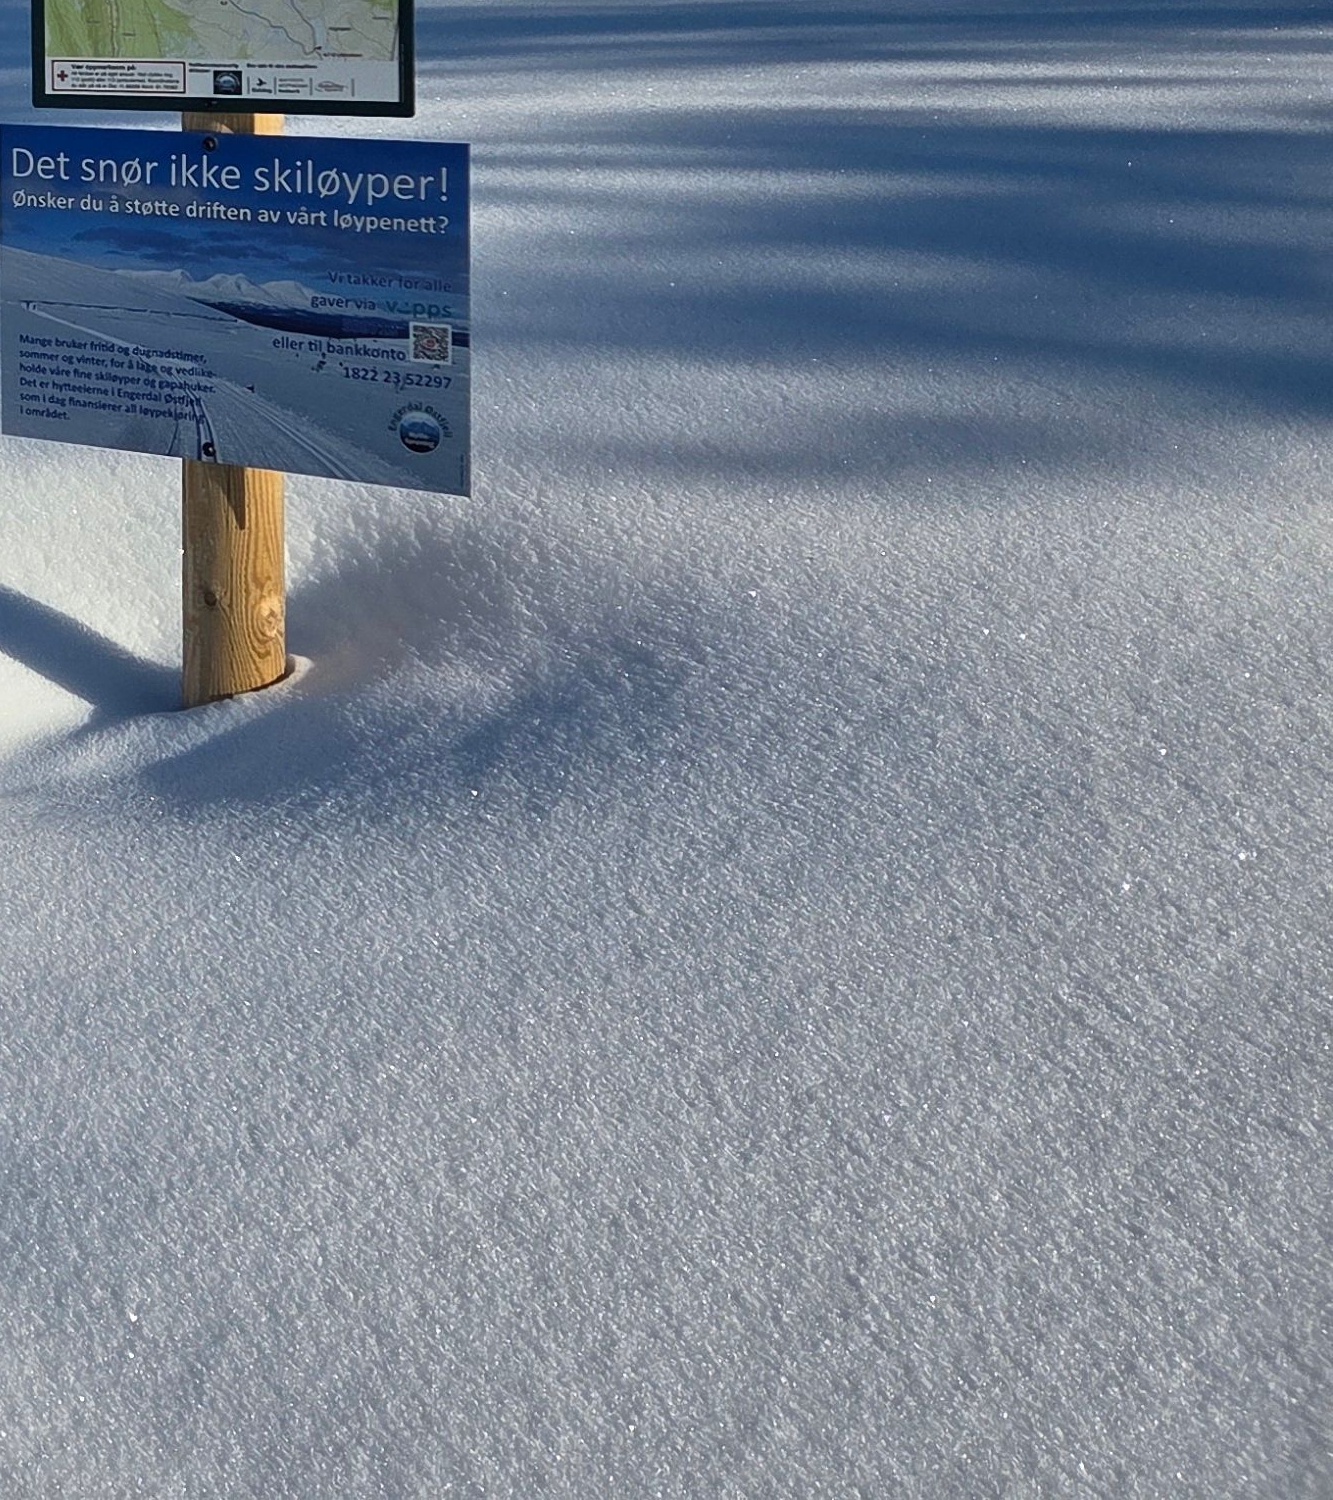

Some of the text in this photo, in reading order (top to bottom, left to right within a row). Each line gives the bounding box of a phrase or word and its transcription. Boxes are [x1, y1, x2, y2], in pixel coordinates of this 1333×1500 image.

[12, 148, 448, 206] Det snør ikke skiløyper!
[12, 189, 449, 234] Ønsker du å støtte driften av vårt løypenett?
[327, 271, 452, 293] Vi takker for alle
[310, 296, 351, 309] gaver
[354, 299, 376, 311] via
[19, 334, 207, 364] Mange bruker fritid og dugnadstimer,
[272, 337, 407, 361] eller til bankkonto
[19, 351, 59, 361] sommer
[62, 354, 74, 365] og
[76, 354, 108, 368] vinter,
[110, 358, 125, 368] for
[127, 358, 133, 370] å
[136, 359, 158, 374] lage
[160, 365, 173, 376] og
[19, 363, 216, 394] holde våre fine skiløyper og gapahuker.
[19, 377, 37, 387] Det
[39, 380, 50, 389] er
[52, 379, 109, 397] hytteeierne
[117, 388, 162, 402] Engerdal
[344, 366, 452, 389] 1822 23 52297
[20, 393, 41, 403] som
[48, 395, 67, 407] dag
[68, 396, 122, 413] finansierer
[124, 402, 137, 414] all
[25, 406, 70, 420] området.
